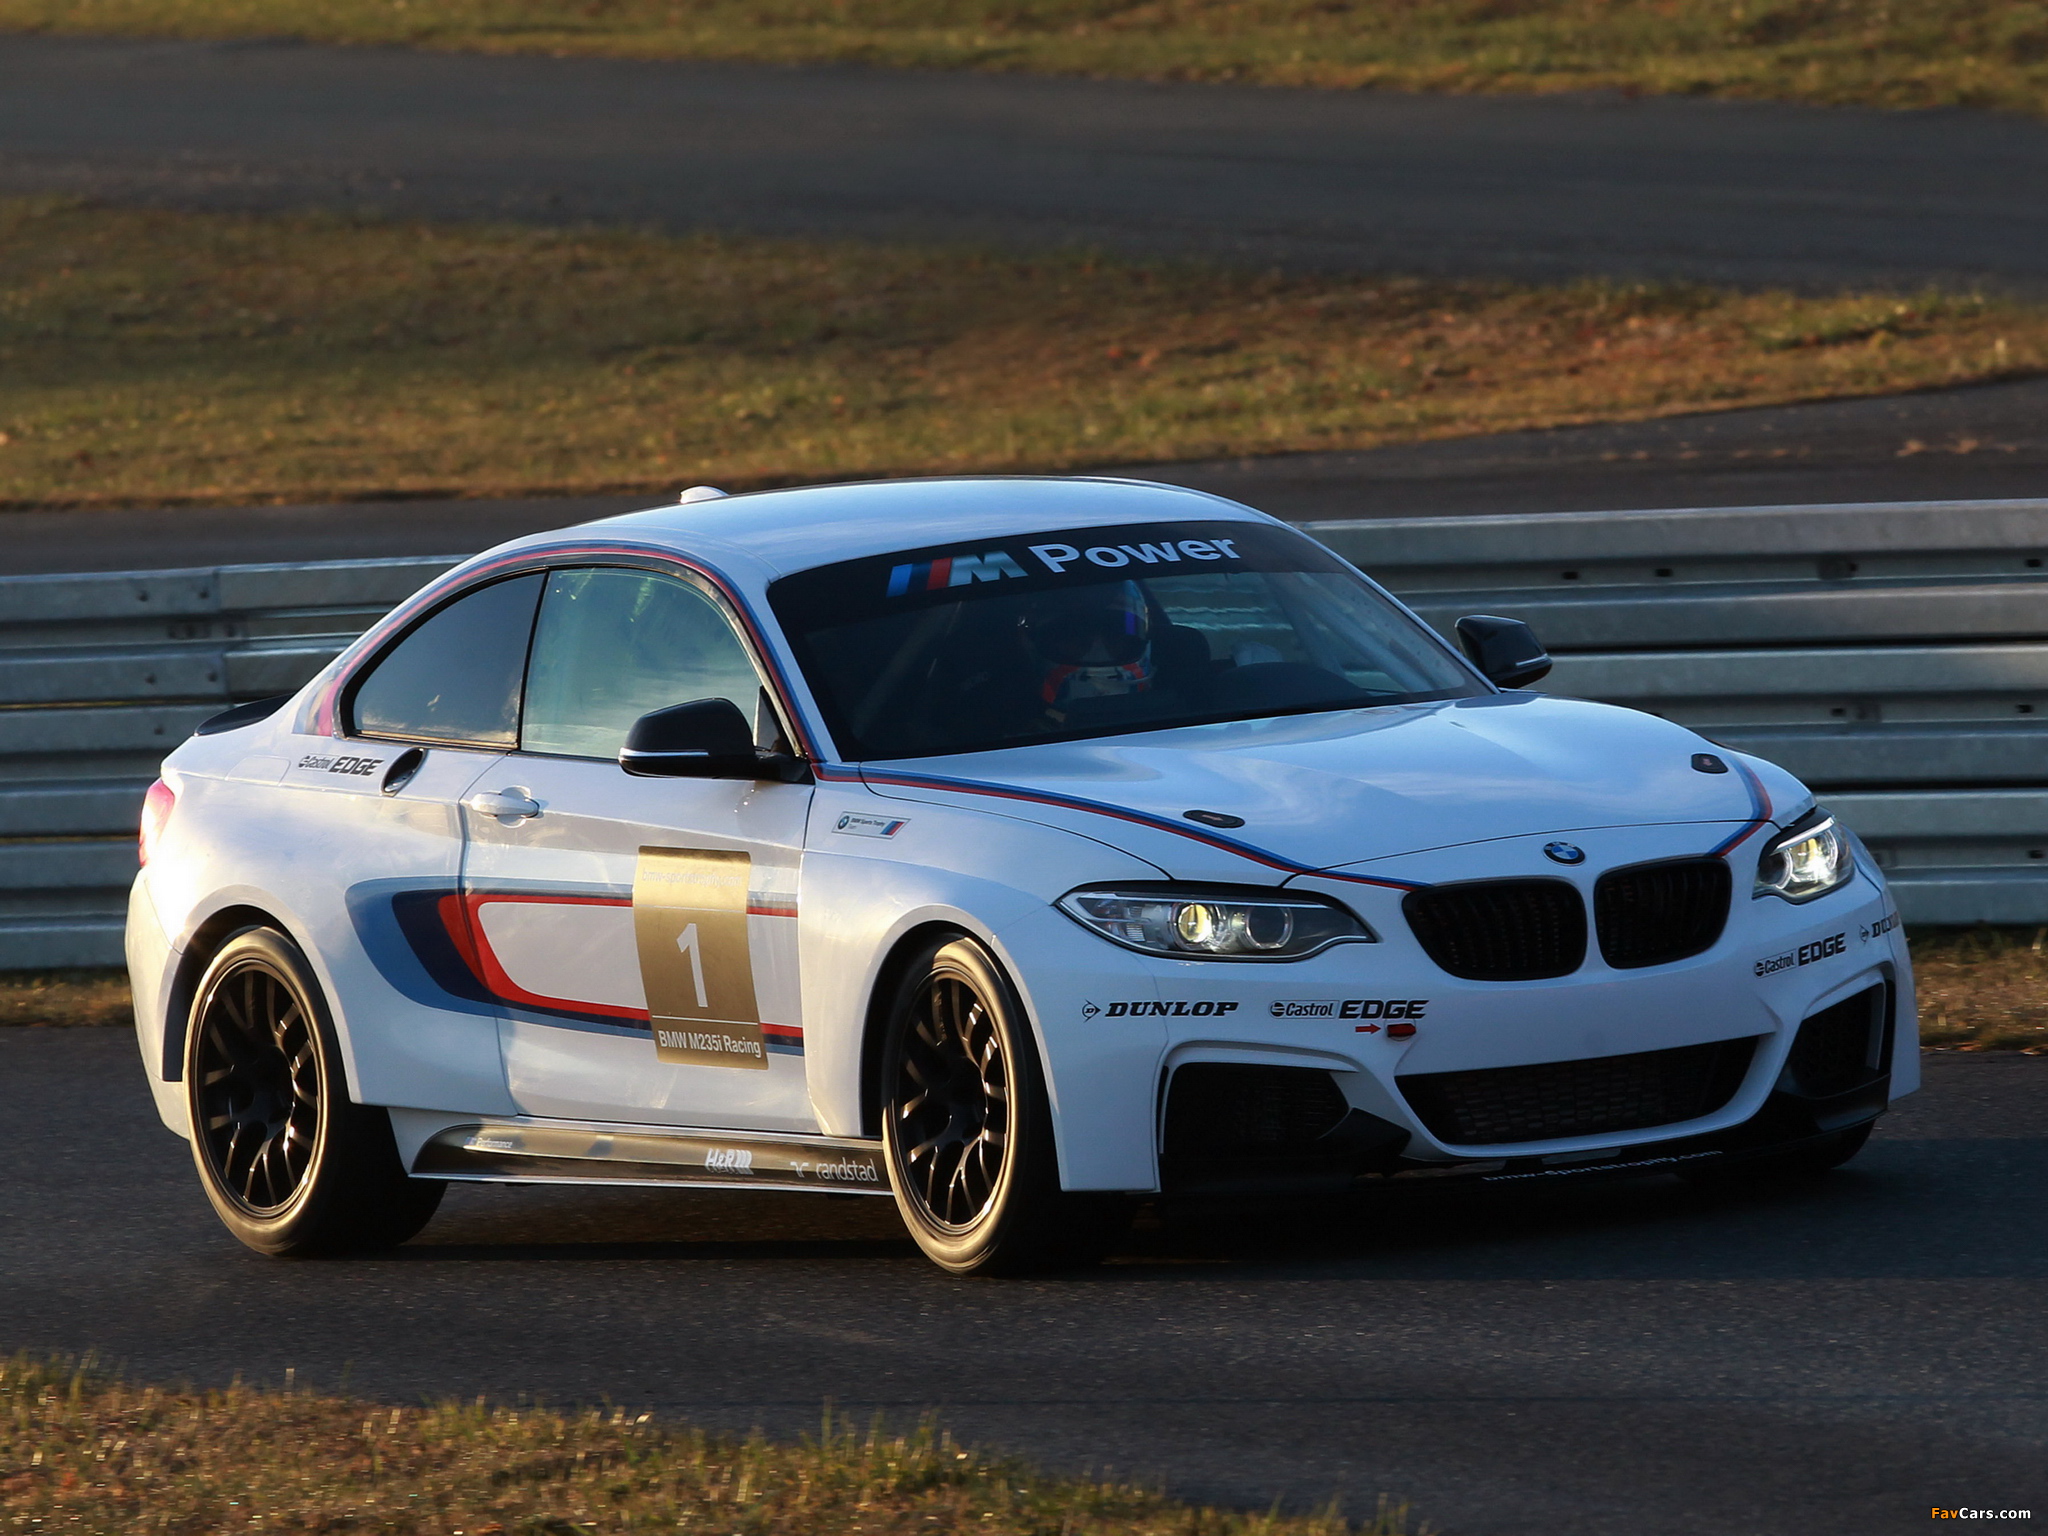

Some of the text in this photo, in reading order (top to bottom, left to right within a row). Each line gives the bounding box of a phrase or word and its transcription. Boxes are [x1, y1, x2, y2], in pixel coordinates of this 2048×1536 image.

[1029, 538, 1241, 574] Power
[328, 756, 385, 776] EDGE
[676, 923, 708, 1008] 1
[1765, 932, 1847, 974] Castrol EDGE
[1105, 1001, 1239, 1017] DUNLOP
[1286, 1000, 1429, 1019] Castrol EDGE
[658, 1030, 762, 1059] BMW M235i Racing
[816, 1157, 879, 1182] randstad
